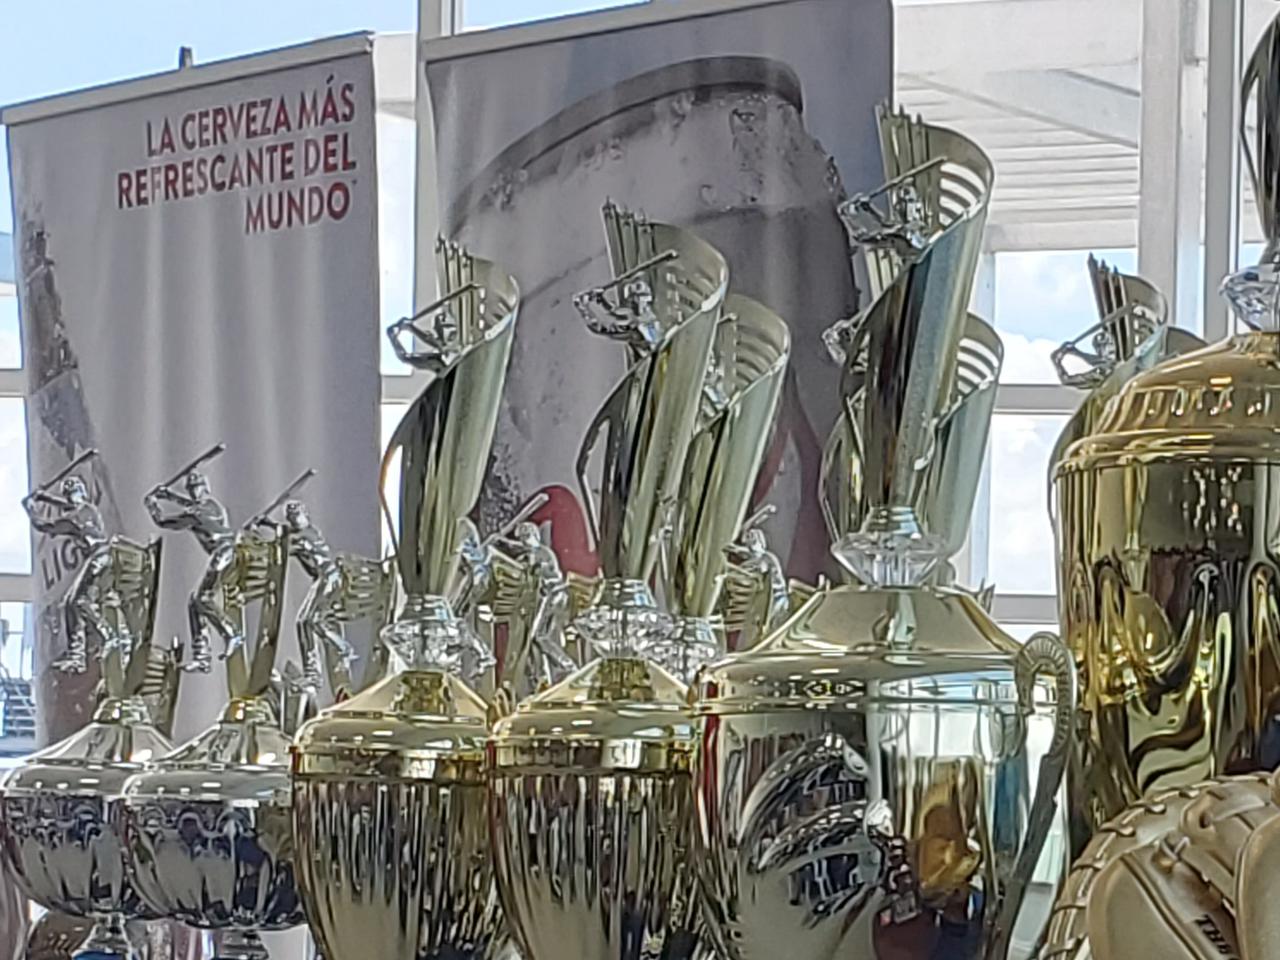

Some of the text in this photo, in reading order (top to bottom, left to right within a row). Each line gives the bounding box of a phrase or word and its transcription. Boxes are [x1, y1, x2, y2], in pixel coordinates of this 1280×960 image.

[146, 74, 356, 157] LA CERVEZA MÁS
[117, 132, 357, 210] REFRESCANTE DEL
[245, 181, 351, 235] MUNDO
[1194, 913, 1233, 955] THE
